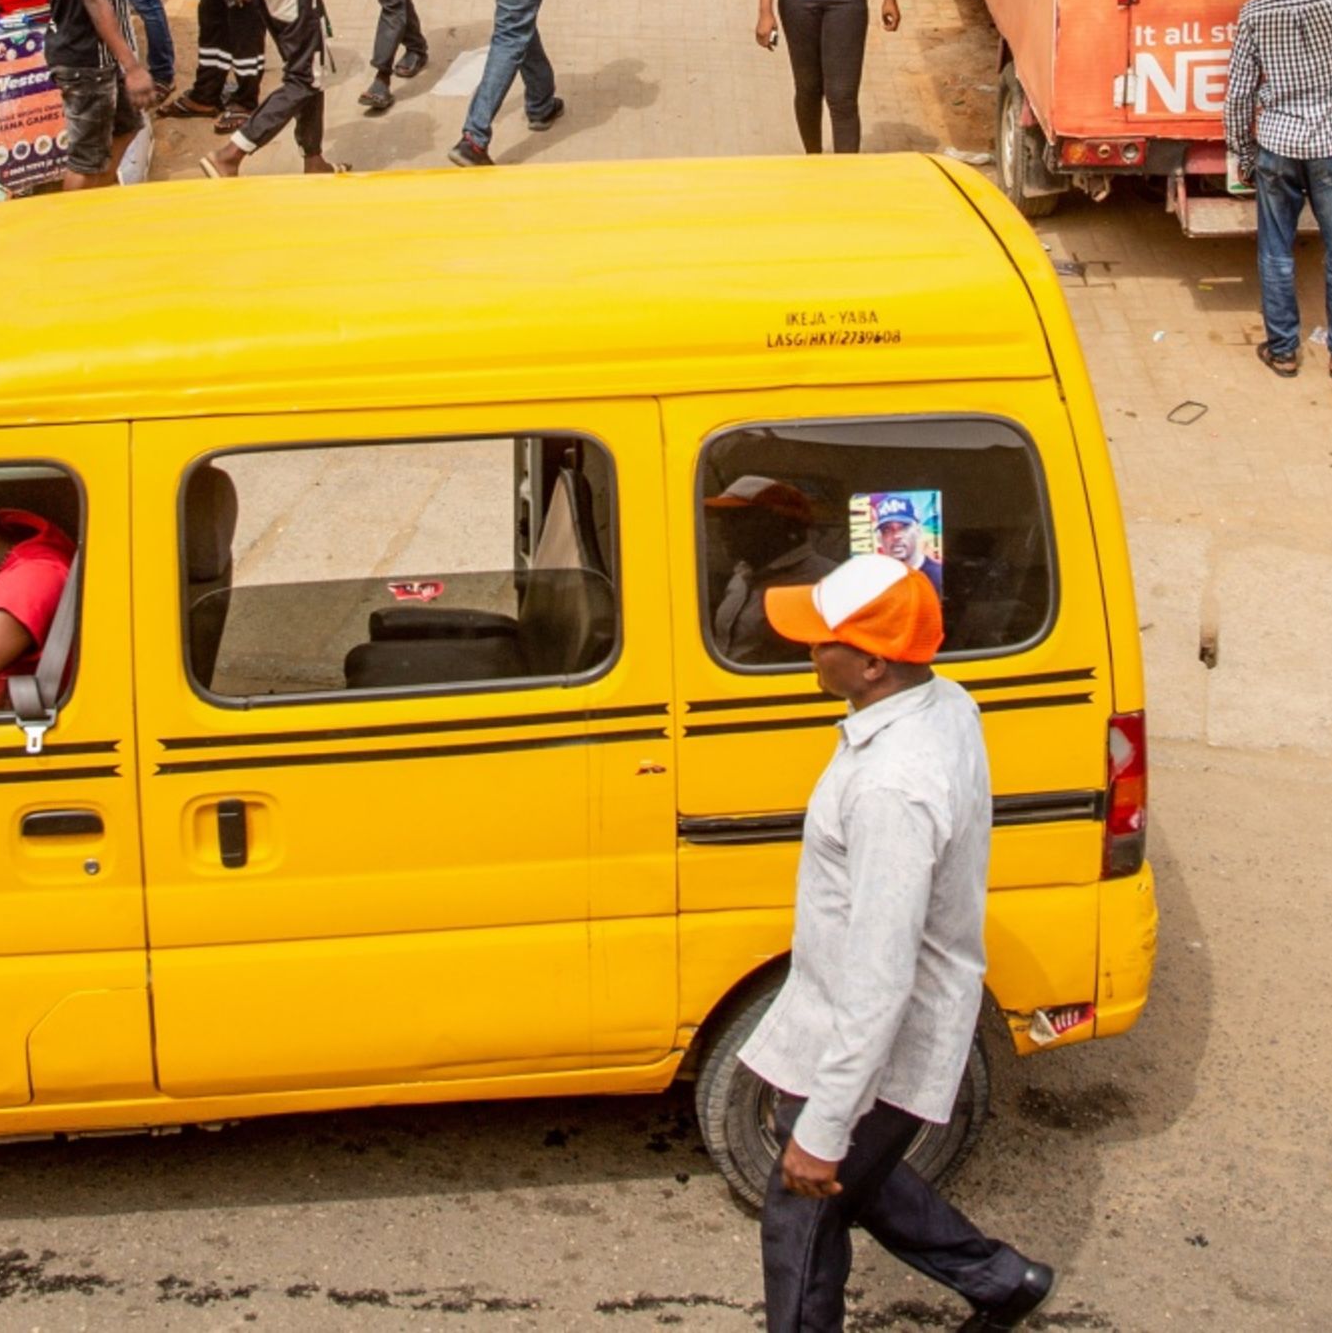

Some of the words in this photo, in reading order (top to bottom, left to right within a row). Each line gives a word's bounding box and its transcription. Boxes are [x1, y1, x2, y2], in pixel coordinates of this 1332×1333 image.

[1135, 25, 1156, 47] It
[1165, 22, 1202, 45] all
[786, 311, 826, 326] IKEJA
[839, 309, 878, 325] YABA
